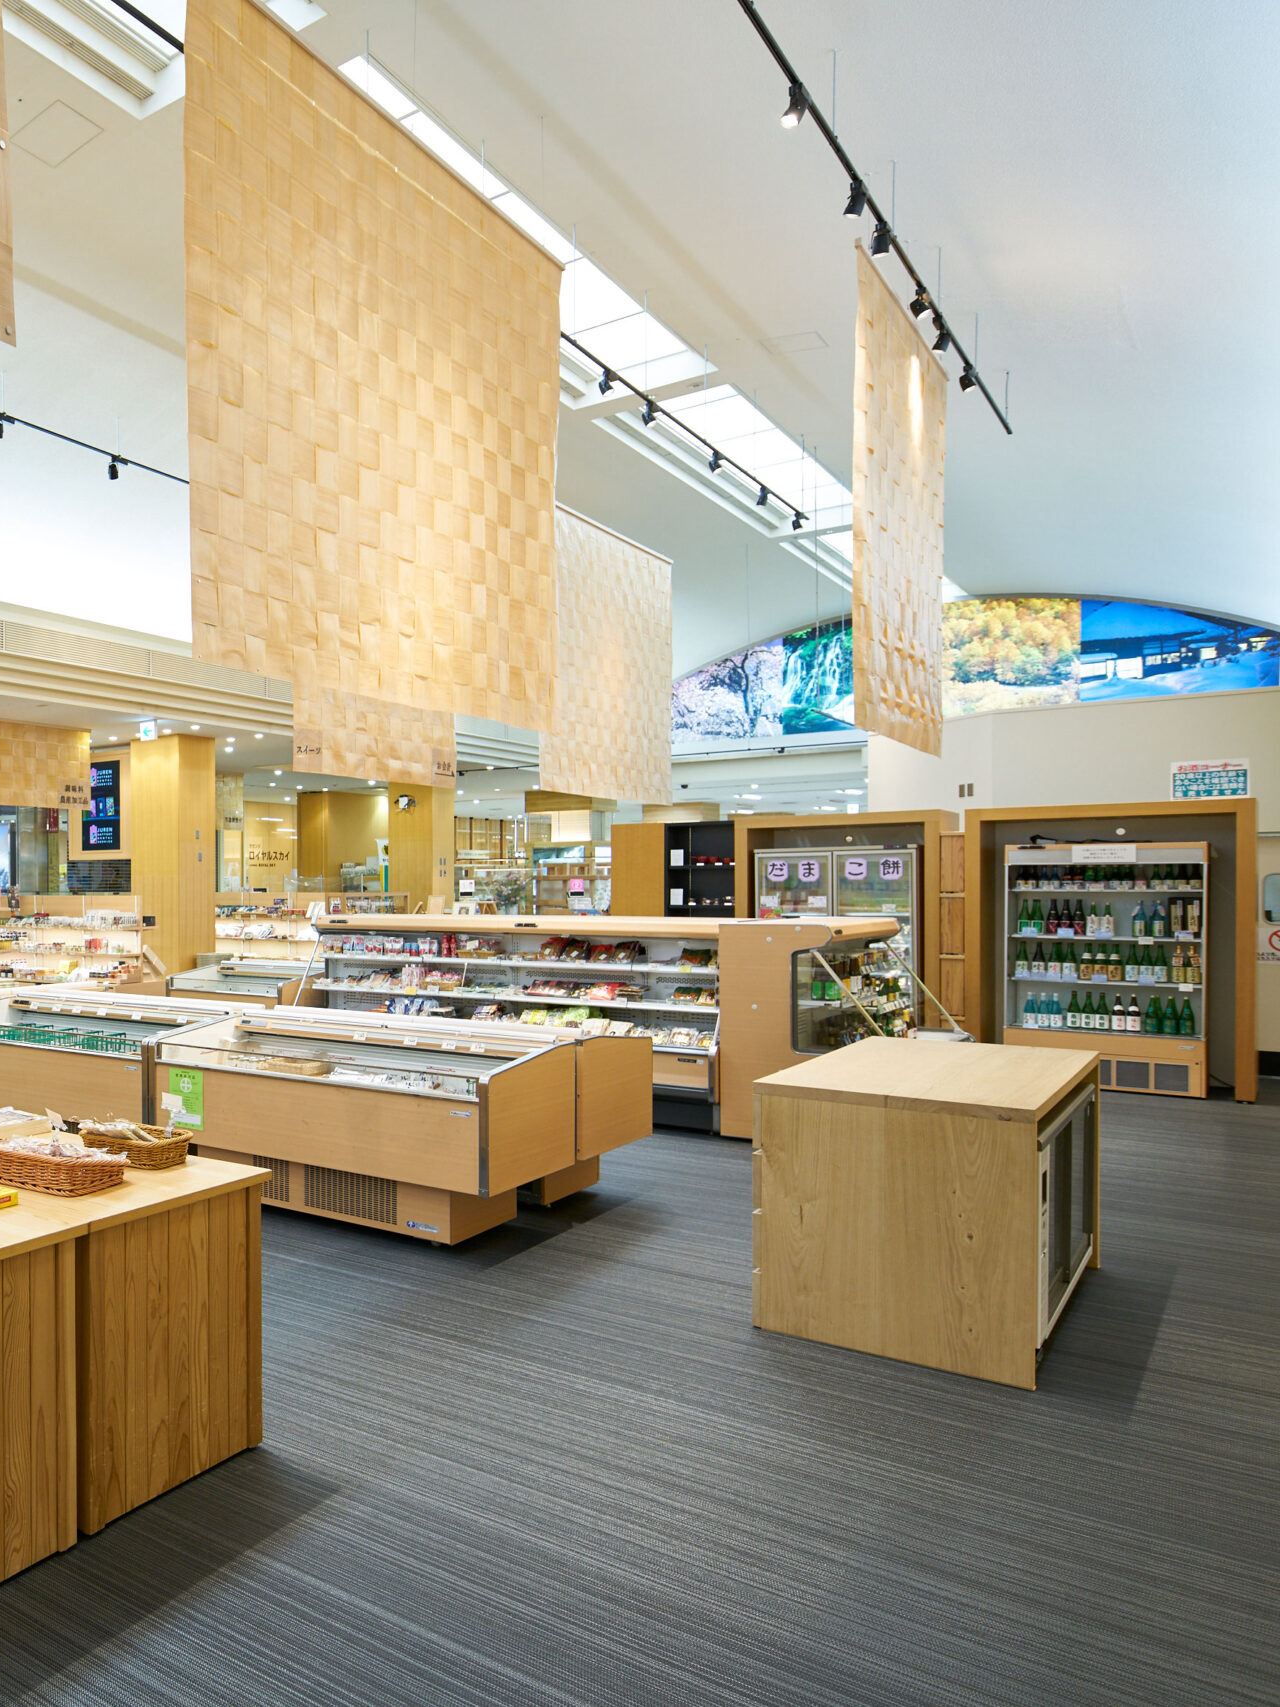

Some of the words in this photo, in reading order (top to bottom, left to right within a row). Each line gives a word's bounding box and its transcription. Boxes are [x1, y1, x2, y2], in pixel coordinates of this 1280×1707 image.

[296, 745, 321, 755] スイーツ
[249, 851, 290, 861] ロイヤルスカイ
[768, 859, 902, 878] だまこ餅
